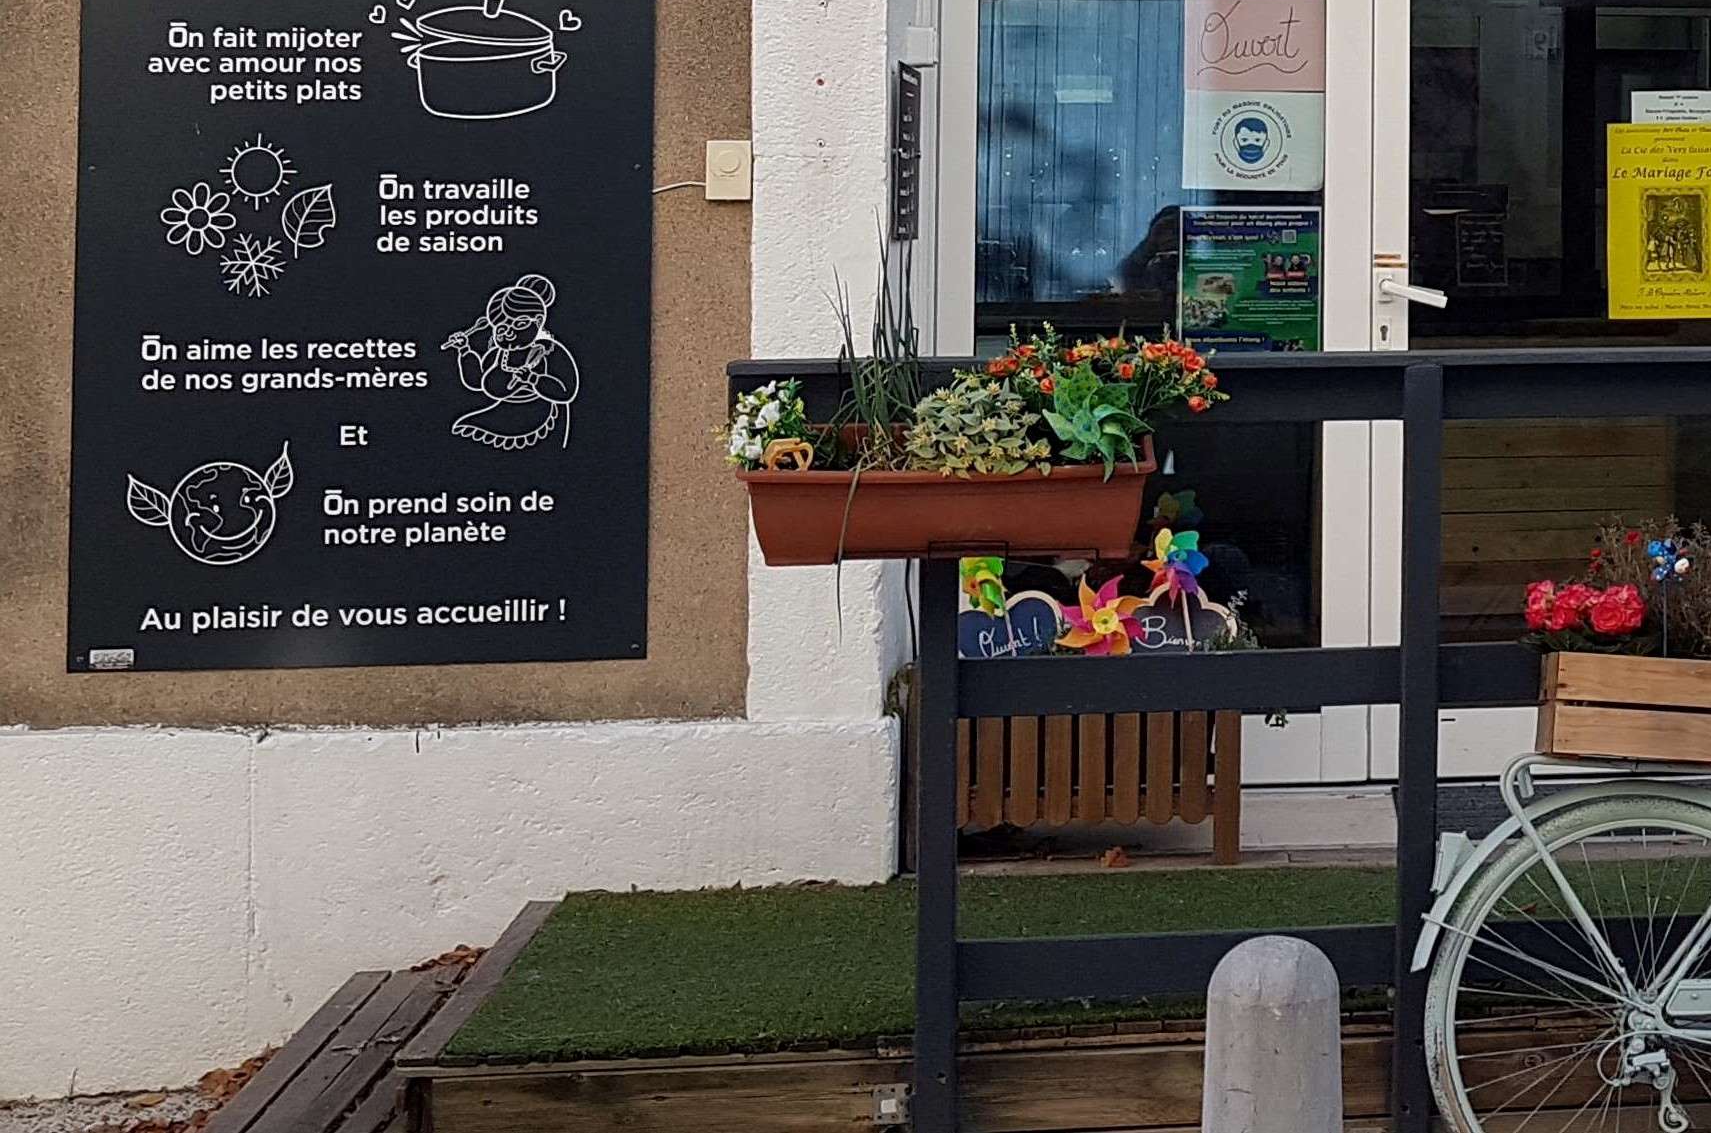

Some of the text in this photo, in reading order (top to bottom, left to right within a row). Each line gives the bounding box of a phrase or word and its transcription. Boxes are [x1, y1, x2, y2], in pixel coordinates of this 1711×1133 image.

[212, 26, 257, 48] fait
[266, 27, 363, 52] mijoter
[147, 57, 362, 73] avec amour nos
[210, 79, 362, 105] petits plats
[1612, 167, 1629, 179] Le
[1632, 165, 1692, 182] Mariage
[422, 178, 530, 200] travaille
[380, 204, 538, 230] les produits
[376, 230, 503, 253] de saison
[186, 338, 253, 361] aime
[261, 338, 298, 360] les
[307, 338, 417, 359] recettes
[141, 366, 428, 394] de nos grands-mères
[340, 425, 368, 446] Et
[368, 492, 447, 519] prend
[456, 491, 511, 513] soin
[520, 490, 554, 512] de
[324, 520, 506, 548] notre planète
[140, 598, 566, 634] Au plaisir de vous accueillir !
